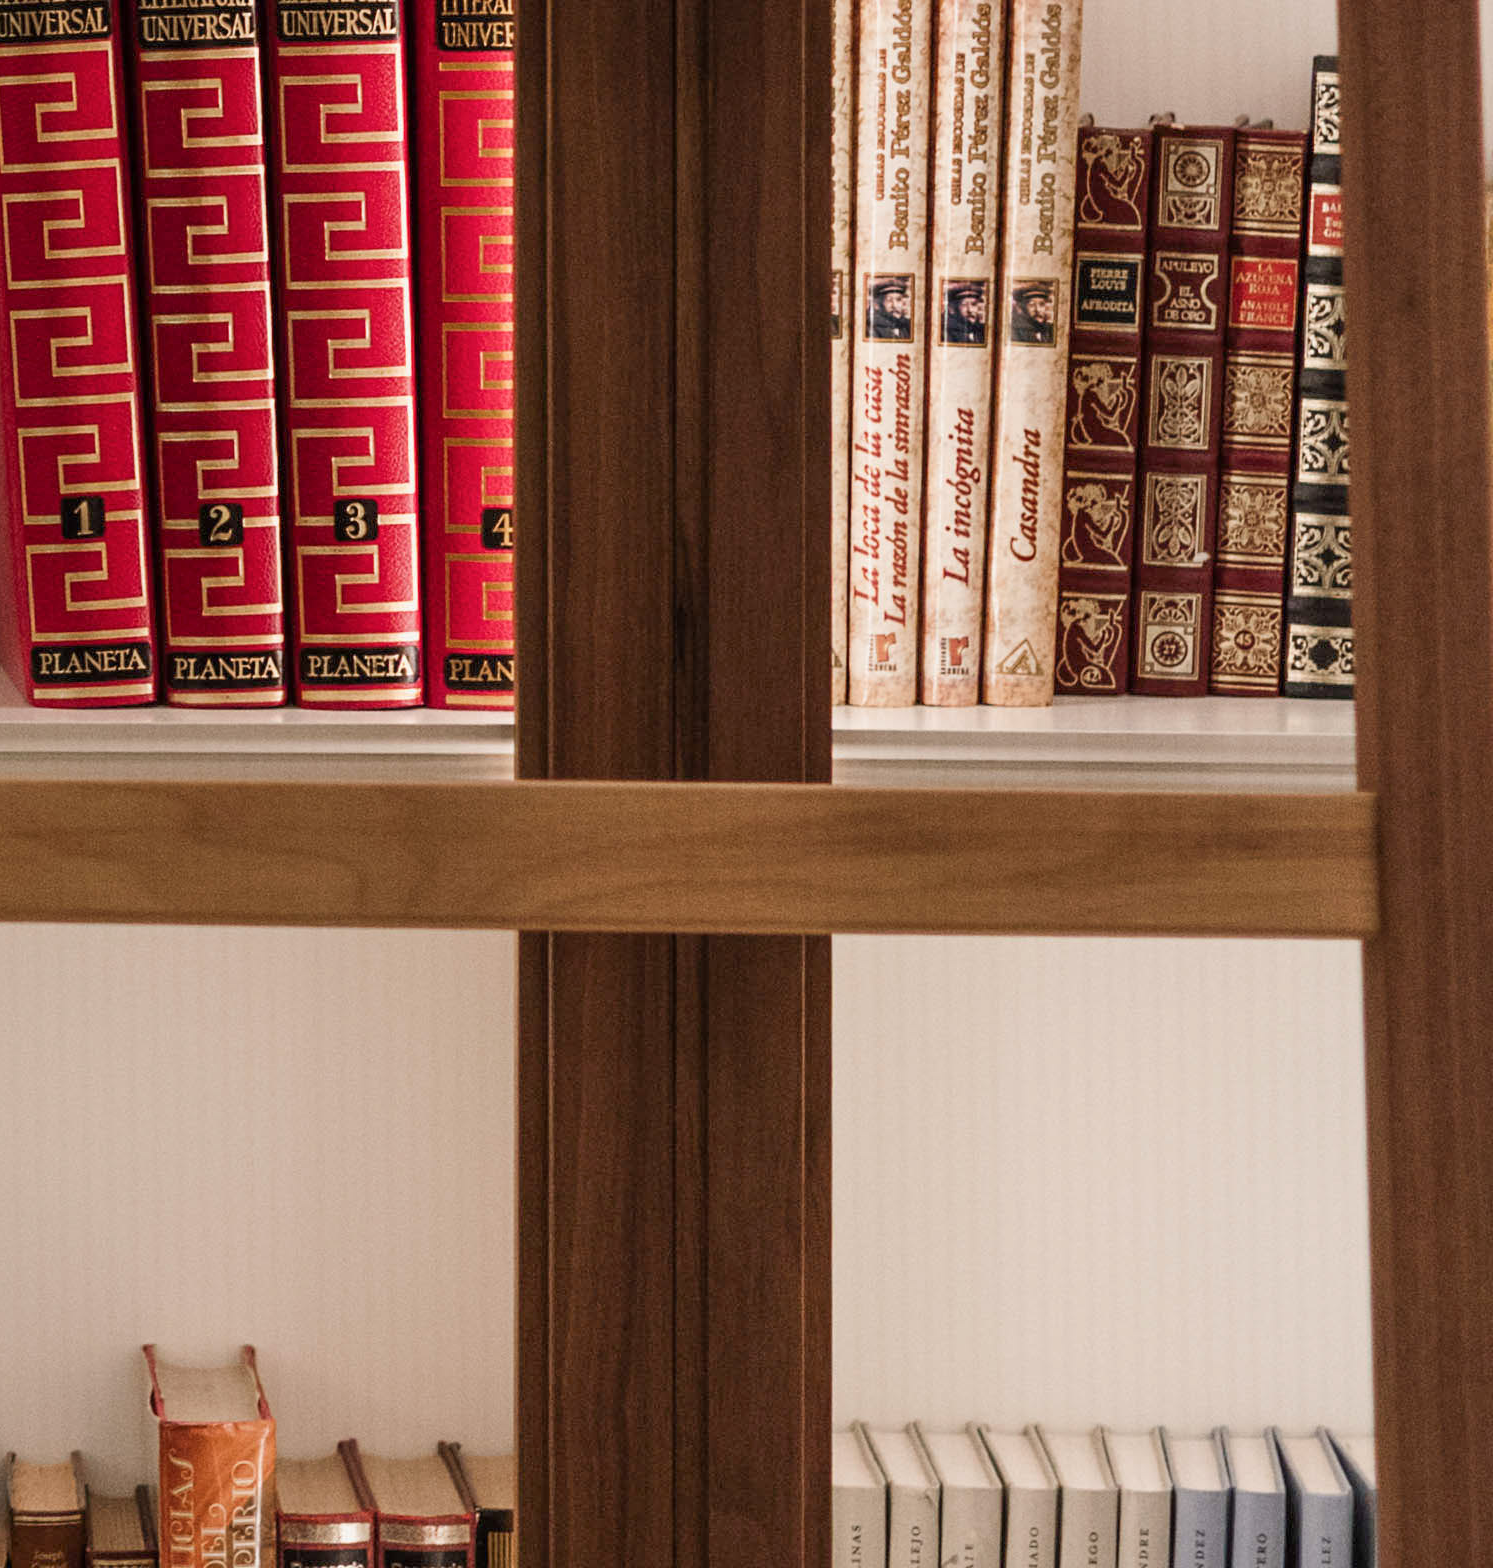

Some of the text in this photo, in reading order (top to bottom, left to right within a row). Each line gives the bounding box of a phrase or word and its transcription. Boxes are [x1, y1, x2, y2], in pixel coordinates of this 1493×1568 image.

[282, 9, 397, 37] UNIVERSAL
[943, 407, 981, 587] La incógnita
[1012, 428, 1043, 564] Casandra
[74, 505, 92, 535] 1
[208, 508, 233, 541] 2
[344, 505, 367, 536] 3
[40, 650, 146, 675] PLANETA
[176, 657, 279, 678] PLANETA
[308, 654, 413, 677] PLANETA
